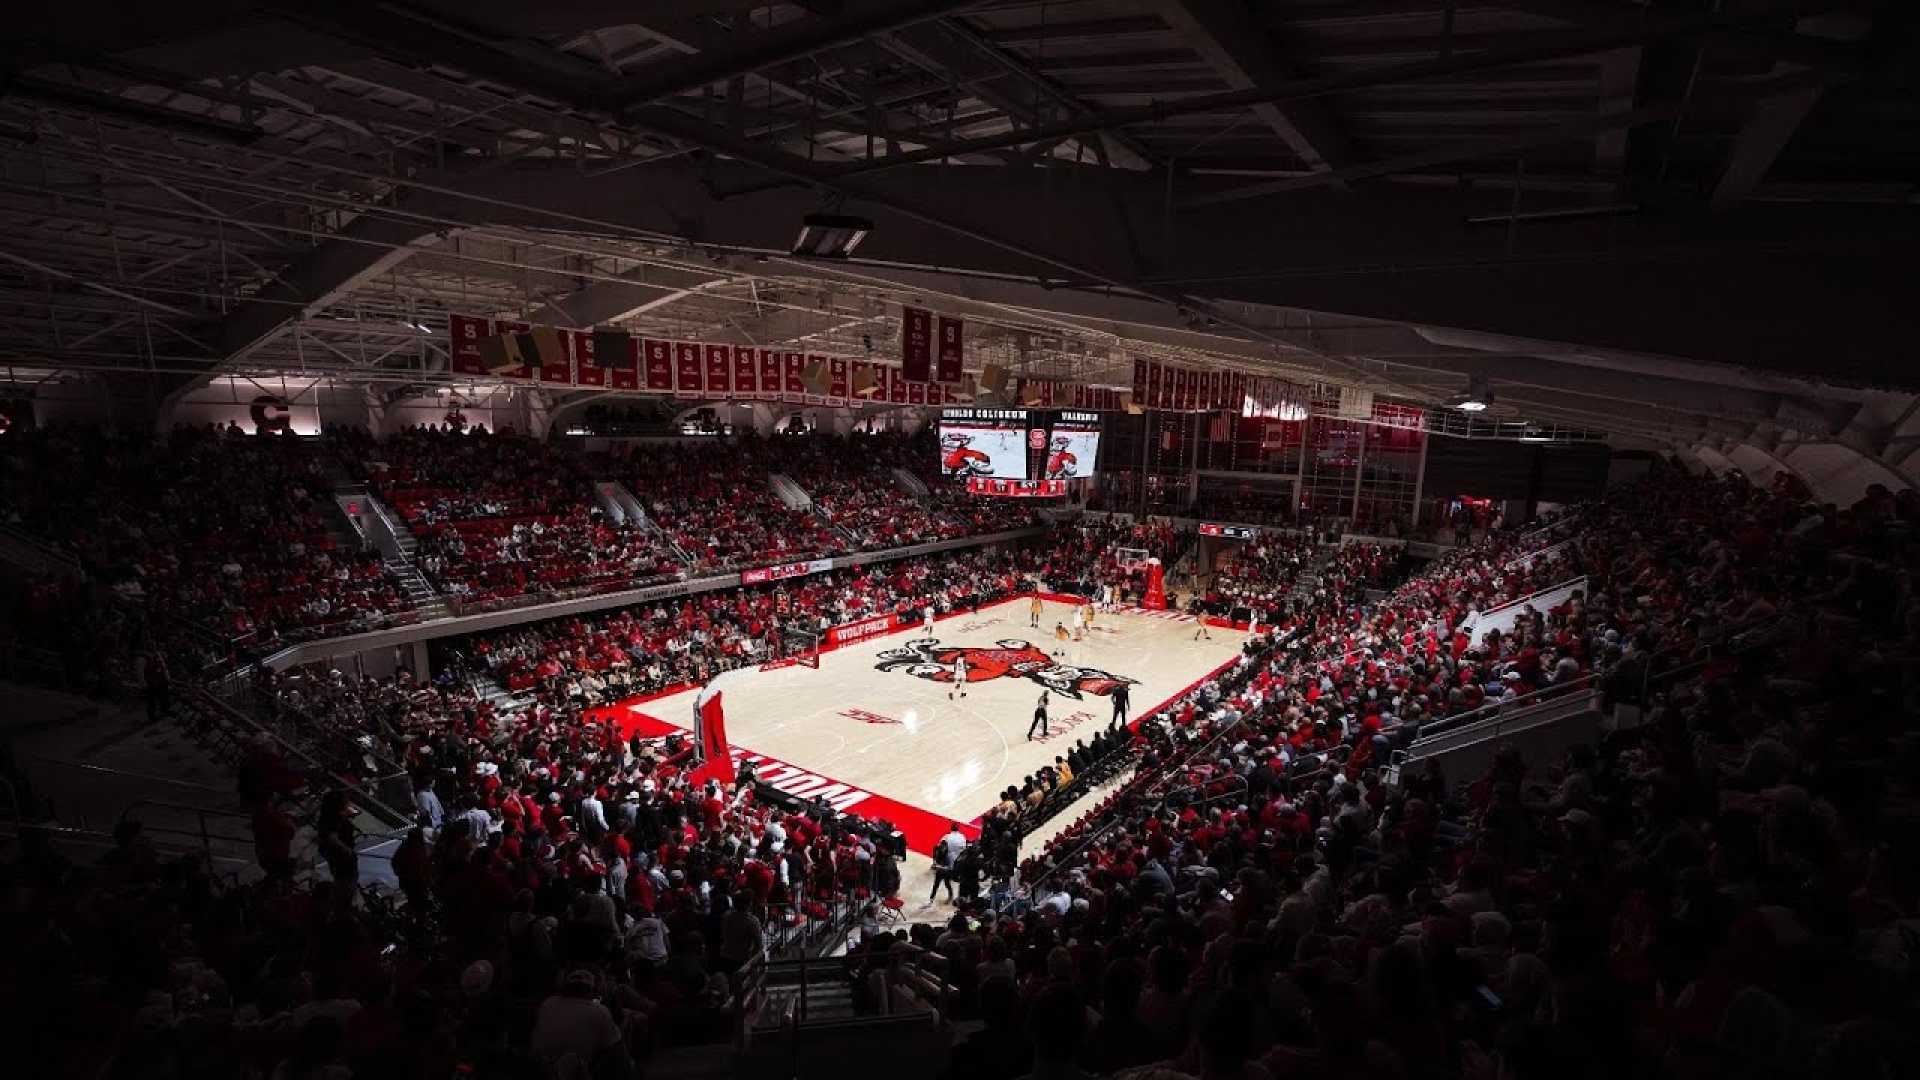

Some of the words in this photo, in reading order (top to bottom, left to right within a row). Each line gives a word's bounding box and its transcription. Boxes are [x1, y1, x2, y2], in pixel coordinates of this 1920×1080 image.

[465, 324, 477, 339] S
[654, 347, 664, 359] S
[684, 348, 694, 361] S
[714, 351, 723, 363] S
[741, 352, 750, 364] S
